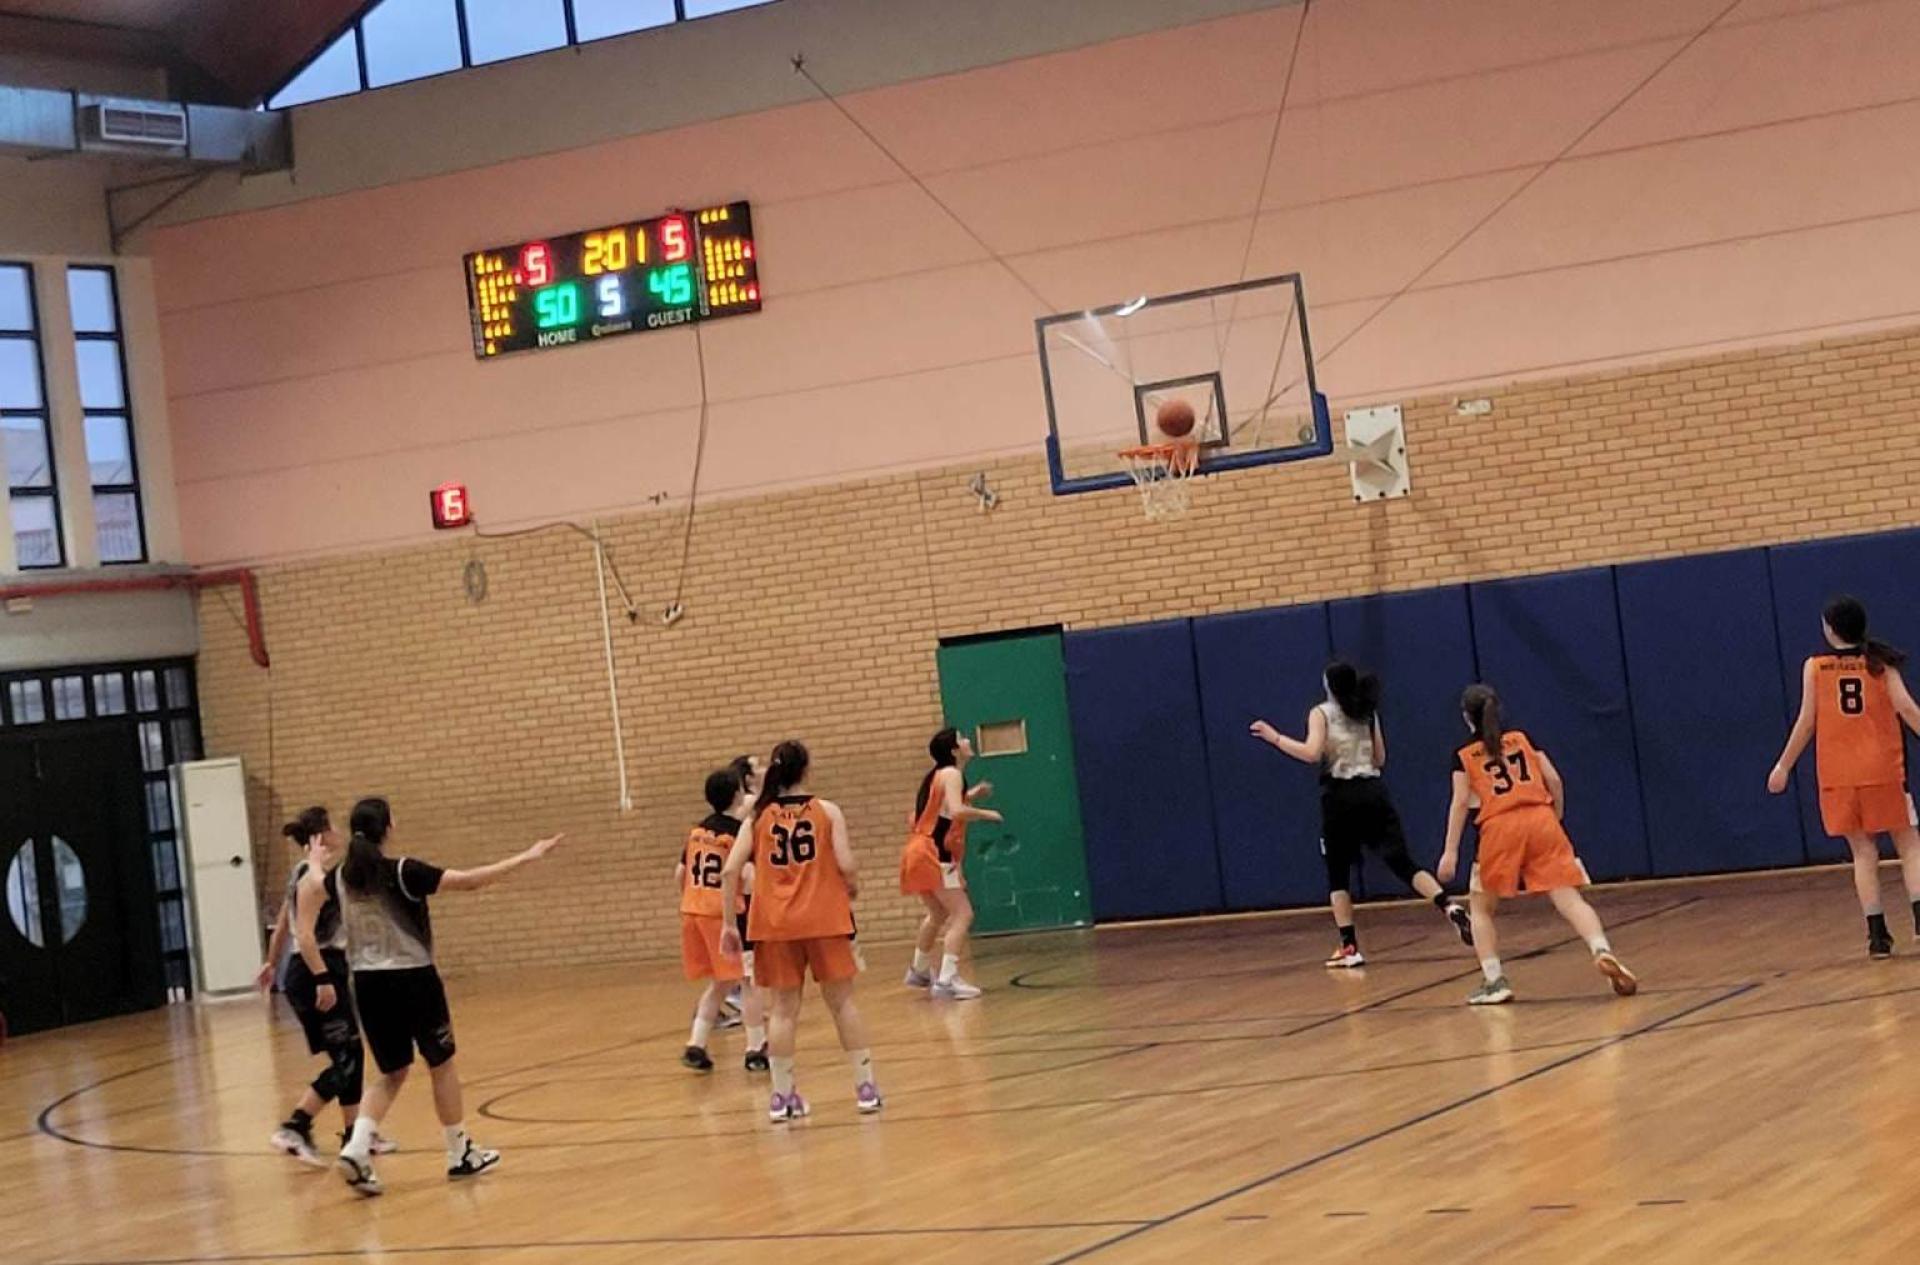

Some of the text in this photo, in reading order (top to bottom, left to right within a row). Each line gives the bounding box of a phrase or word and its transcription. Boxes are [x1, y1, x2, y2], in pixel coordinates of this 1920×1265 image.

[665, 222, 686, 261] 5
[525, 245, 547, 285] 5
[650, 264, 692, 304] 45
[534, 285, 578, 329] 50
[599, 277, 622, 317] 5
[648, 307, 692, 328] GUEST
[538, 329, 576, 348] HOME
[1839, 677, 1863, 715] 8
[1484, 749, 1531, 796] 37
[769, 820, 817, 867] 36
